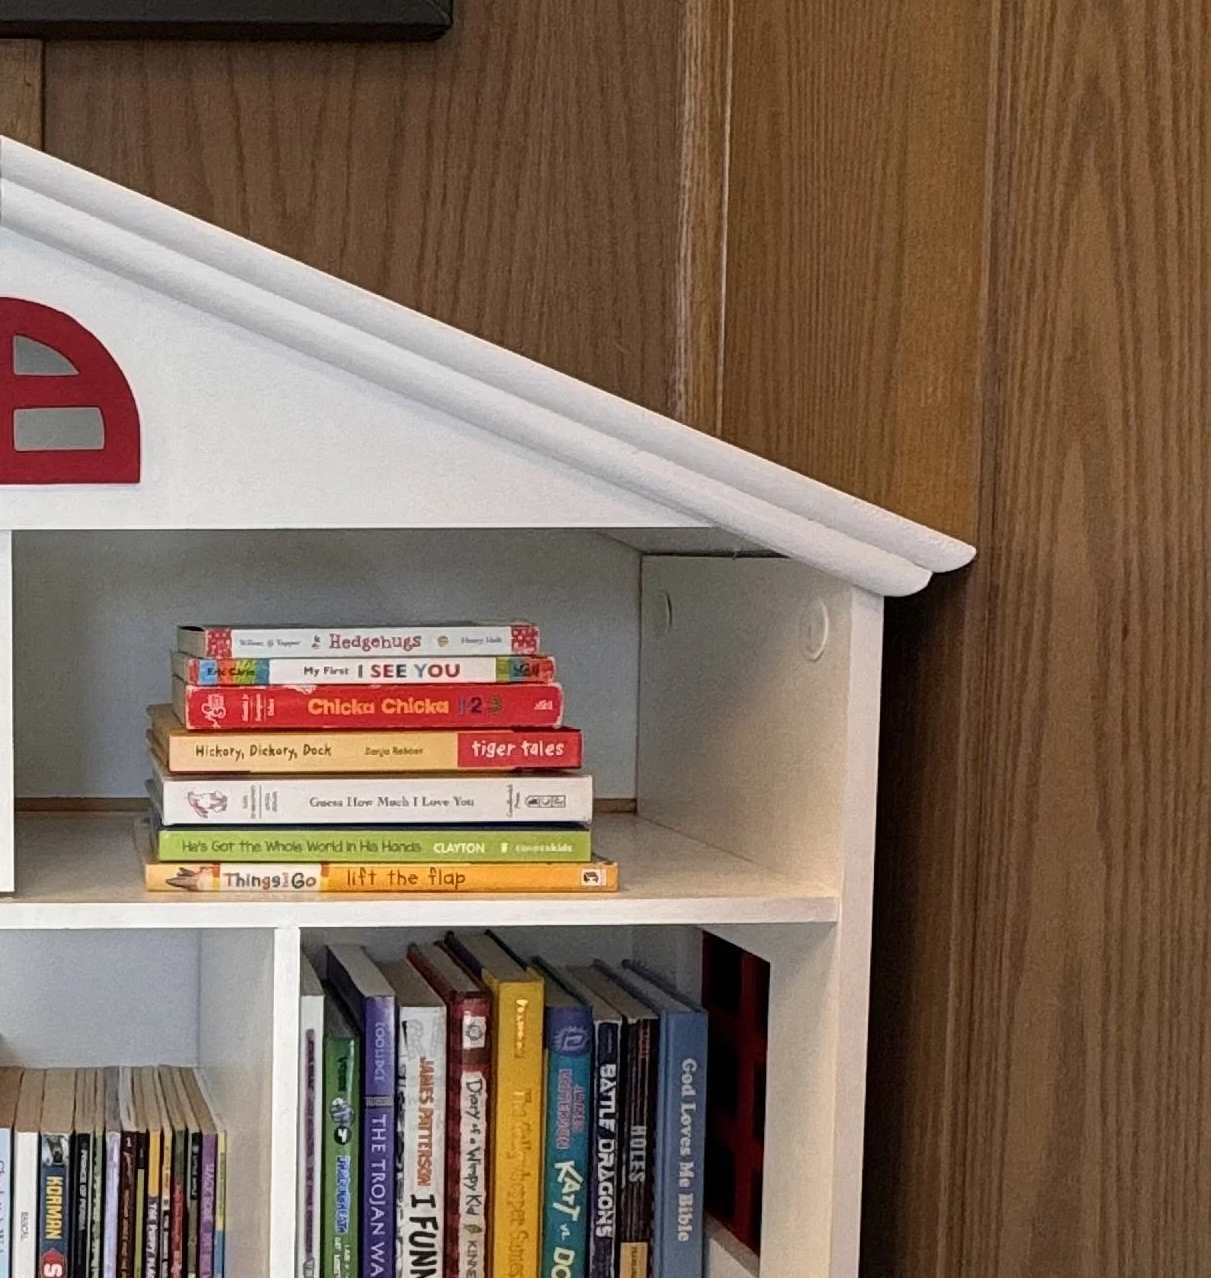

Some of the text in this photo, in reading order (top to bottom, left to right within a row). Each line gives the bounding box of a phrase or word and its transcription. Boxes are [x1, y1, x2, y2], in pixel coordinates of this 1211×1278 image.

[304, 664, 460, 678] My First SEE YOU
[308, 697, 449, 715] Chicka Chicka
[250, 744, 332, 761] Dickory, Dock
[472, 740, 564, 758] tiger tales
[434, 842, 485, 854] CLAYTON
[292, 873, 316, 888] Go
[347, 867, 465, 890] lift the flap
[372, 1114, 386, 1153] THE
[417, 1057, 434, 1187] JAMES PATTERSON
[464, 1079, 483, 1191] Diary Wimpy
[595, 1064, 617, 1238] BATTLE DRAGONS
[628, 1126, 647, 1184] HOLES
[677, 1058, 697, 1242] God Loves Me Bible
[45, 1176, 62, 1239] KORMAN
[369, 1160, 386, 1236] TROJAN
[411, 1194, 435, 1208] I
